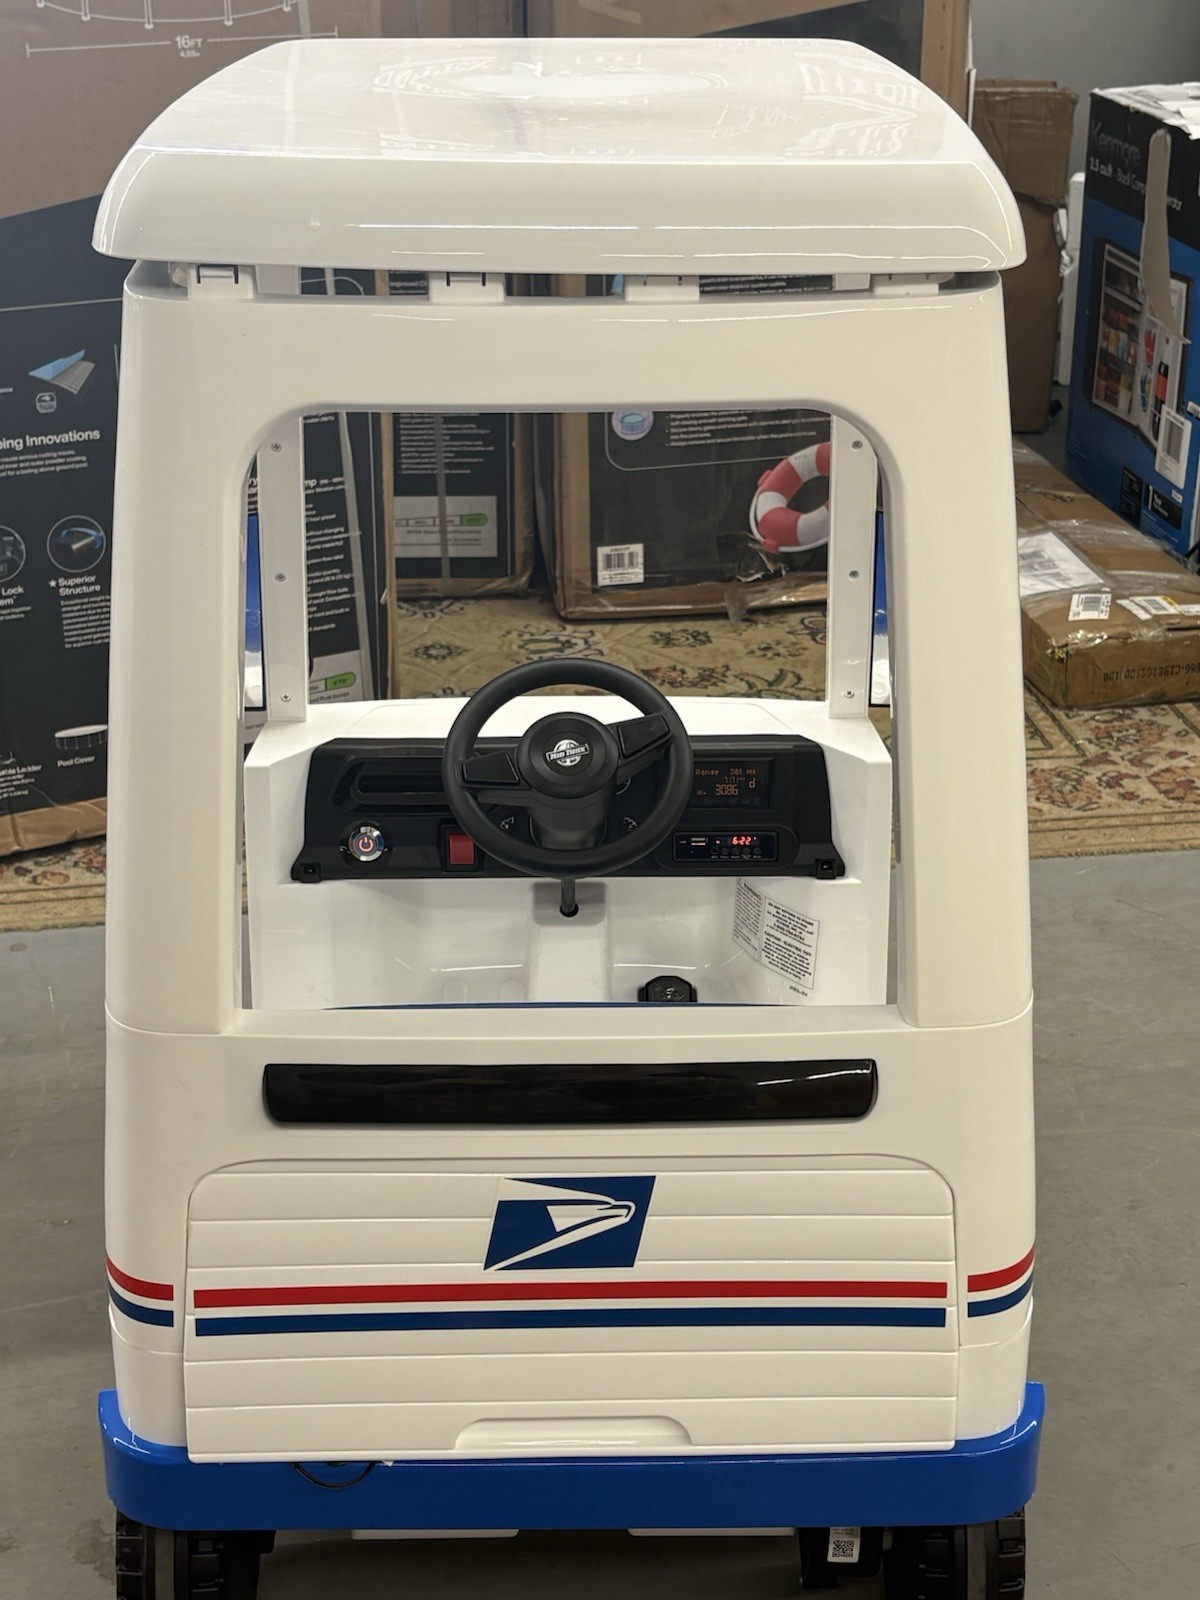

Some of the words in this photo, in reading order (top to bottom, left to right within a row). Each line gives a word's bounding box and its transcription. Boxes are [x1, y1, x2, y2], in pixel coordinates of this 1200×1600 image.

[175, 35, 203, 49] 16FT
[26, 429, 100, 447] Innovations
[58, 575, 97, 587] Superior
[1, 586, 24, 596] Lock
[59, 584, 101, 596] Structure
[57, 758, 74, 768] Pool
[74, 756, 96, 765] Cover
[16, 765, 42, 773] Ladder
[715, 784, 739, 796] 3086
